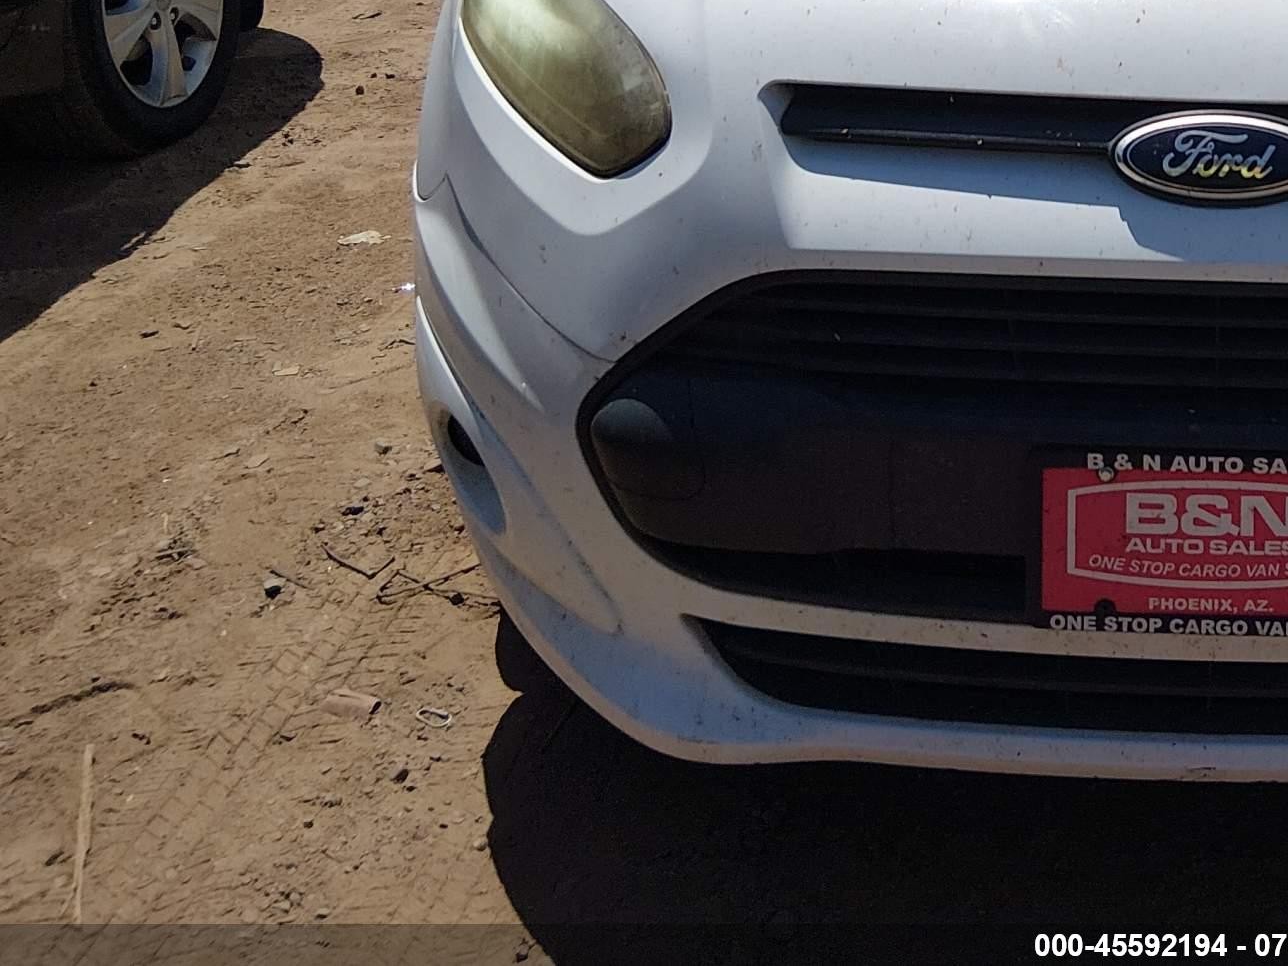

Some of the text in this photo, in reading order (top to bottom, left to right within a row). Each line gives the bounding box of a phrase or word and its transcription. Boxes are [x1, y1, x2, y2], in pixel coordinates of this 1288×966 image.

[1162, 129, 1277, 179] Ford
[1087, 452, 1105, 470] B
[1113, 453, 1133, 471] &
[1142, 454, 1161, 472] N
[1169, 455, 1245, 474] AUTO
[1124, 537, 1205, 555] AUTO
[1088, 553, 1126, 571] ONE
[1128, 559, 1176, 576] STOP
[1178, 563, 1241, 578] CARGO
[1245, 562, 1280, 578] VAN
[1148, 597, 1275, 614] PHOENIX, AZ.
[1049, 614, 1097, 631] ONE
[1103, 615, 1164, 633] STOP
[1169, 618, 1249, 636] CARGO
